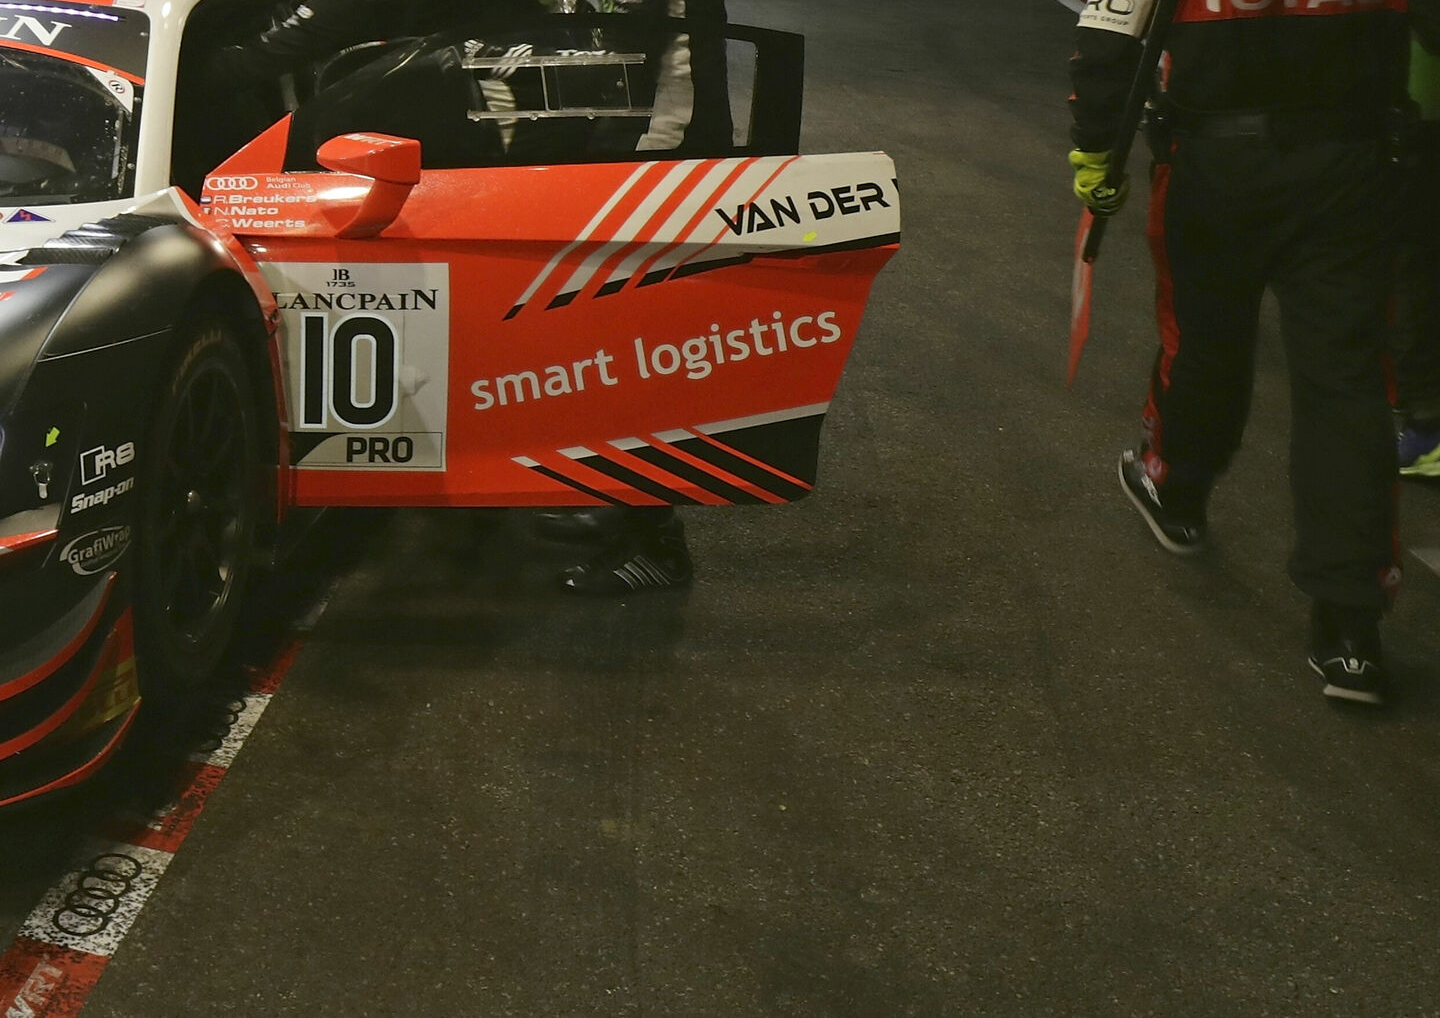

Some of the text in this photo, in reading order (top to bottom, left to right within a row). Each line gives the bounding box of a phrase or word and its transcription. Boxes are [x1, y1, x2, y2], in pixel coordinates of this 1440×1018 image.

[714, 182, 891, 236] VAN DER
[271, 288, 439, 312] LANCPAIN
[299, 313, 400, 430] 10
[469, 309, 842, 411] smart logistics
[90, 441, 136, 479] R8
[345, 435, 415, 464] PRO
[70, 476, 135, 514] Snap-on
